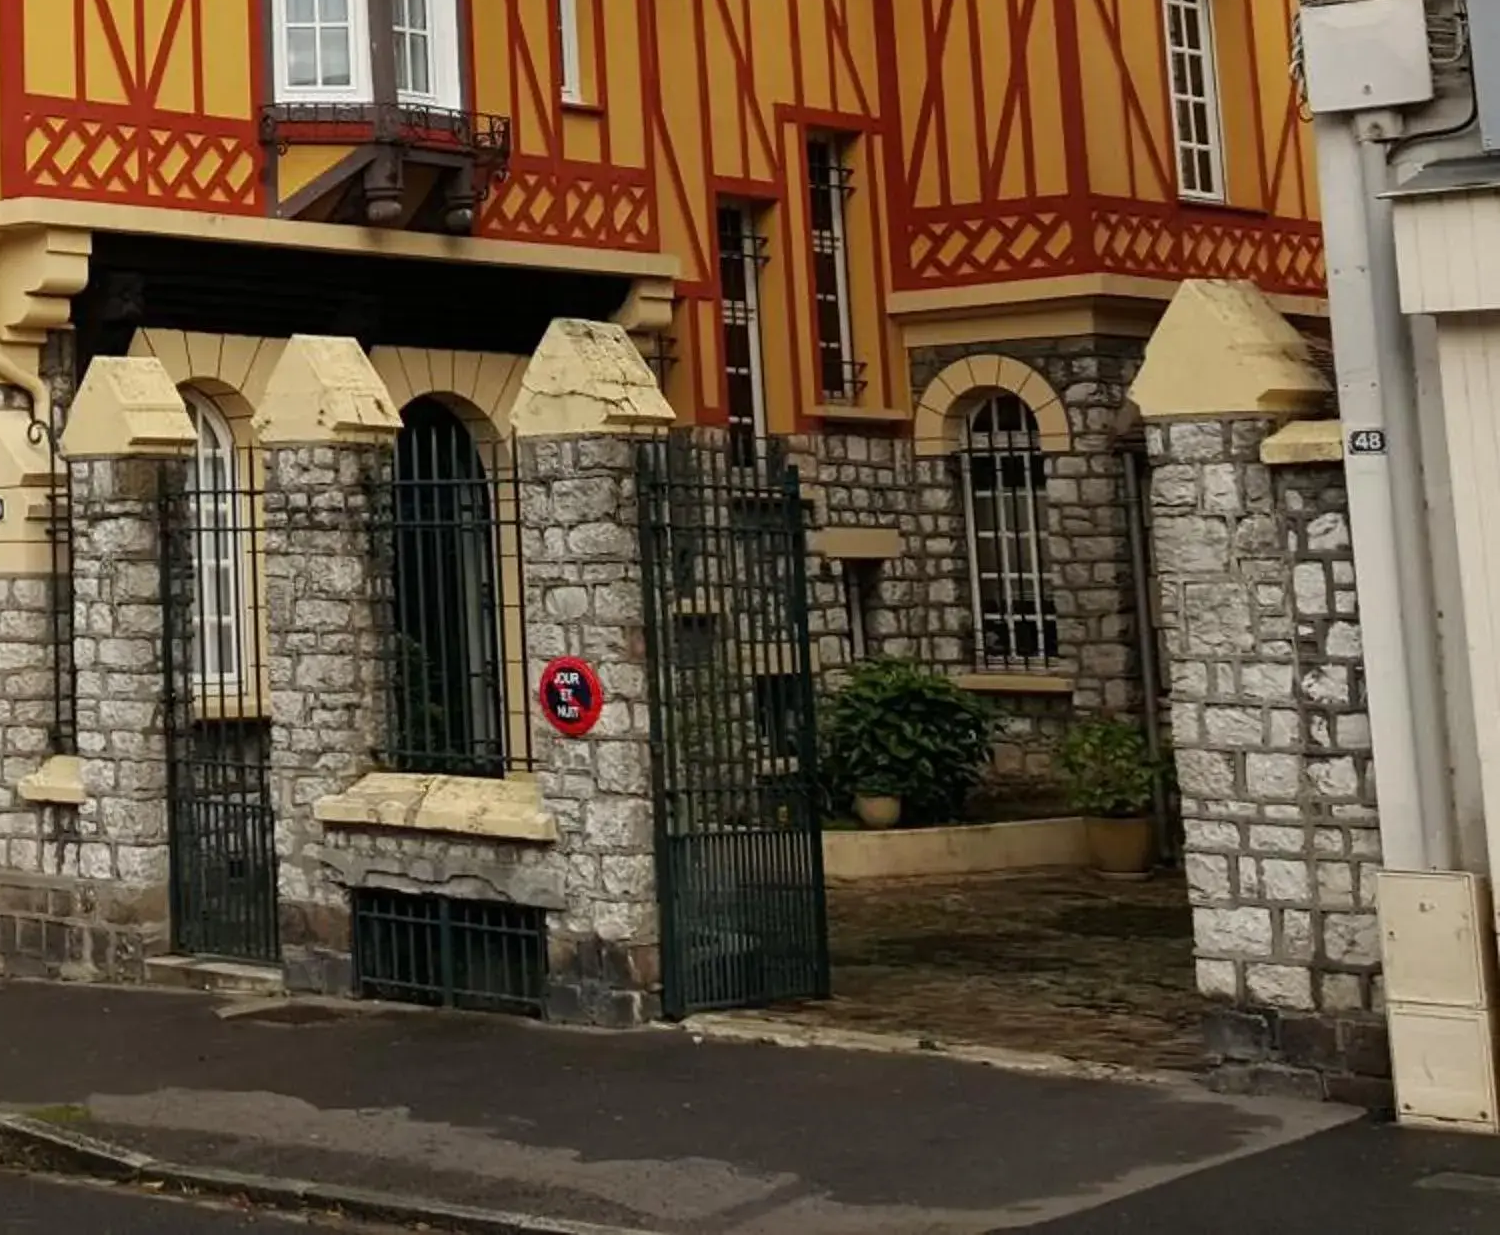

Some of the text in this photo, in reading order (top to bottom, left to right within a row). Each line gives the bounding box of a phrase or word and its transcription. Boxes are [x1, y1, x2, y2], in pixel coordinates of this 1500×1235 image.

[1355, 432, 1382, 450] 48
[553, 672, 581, 685] JOUR
[559, 688, 574, 702] ET
[556, 704, 581, 718] NUIT
